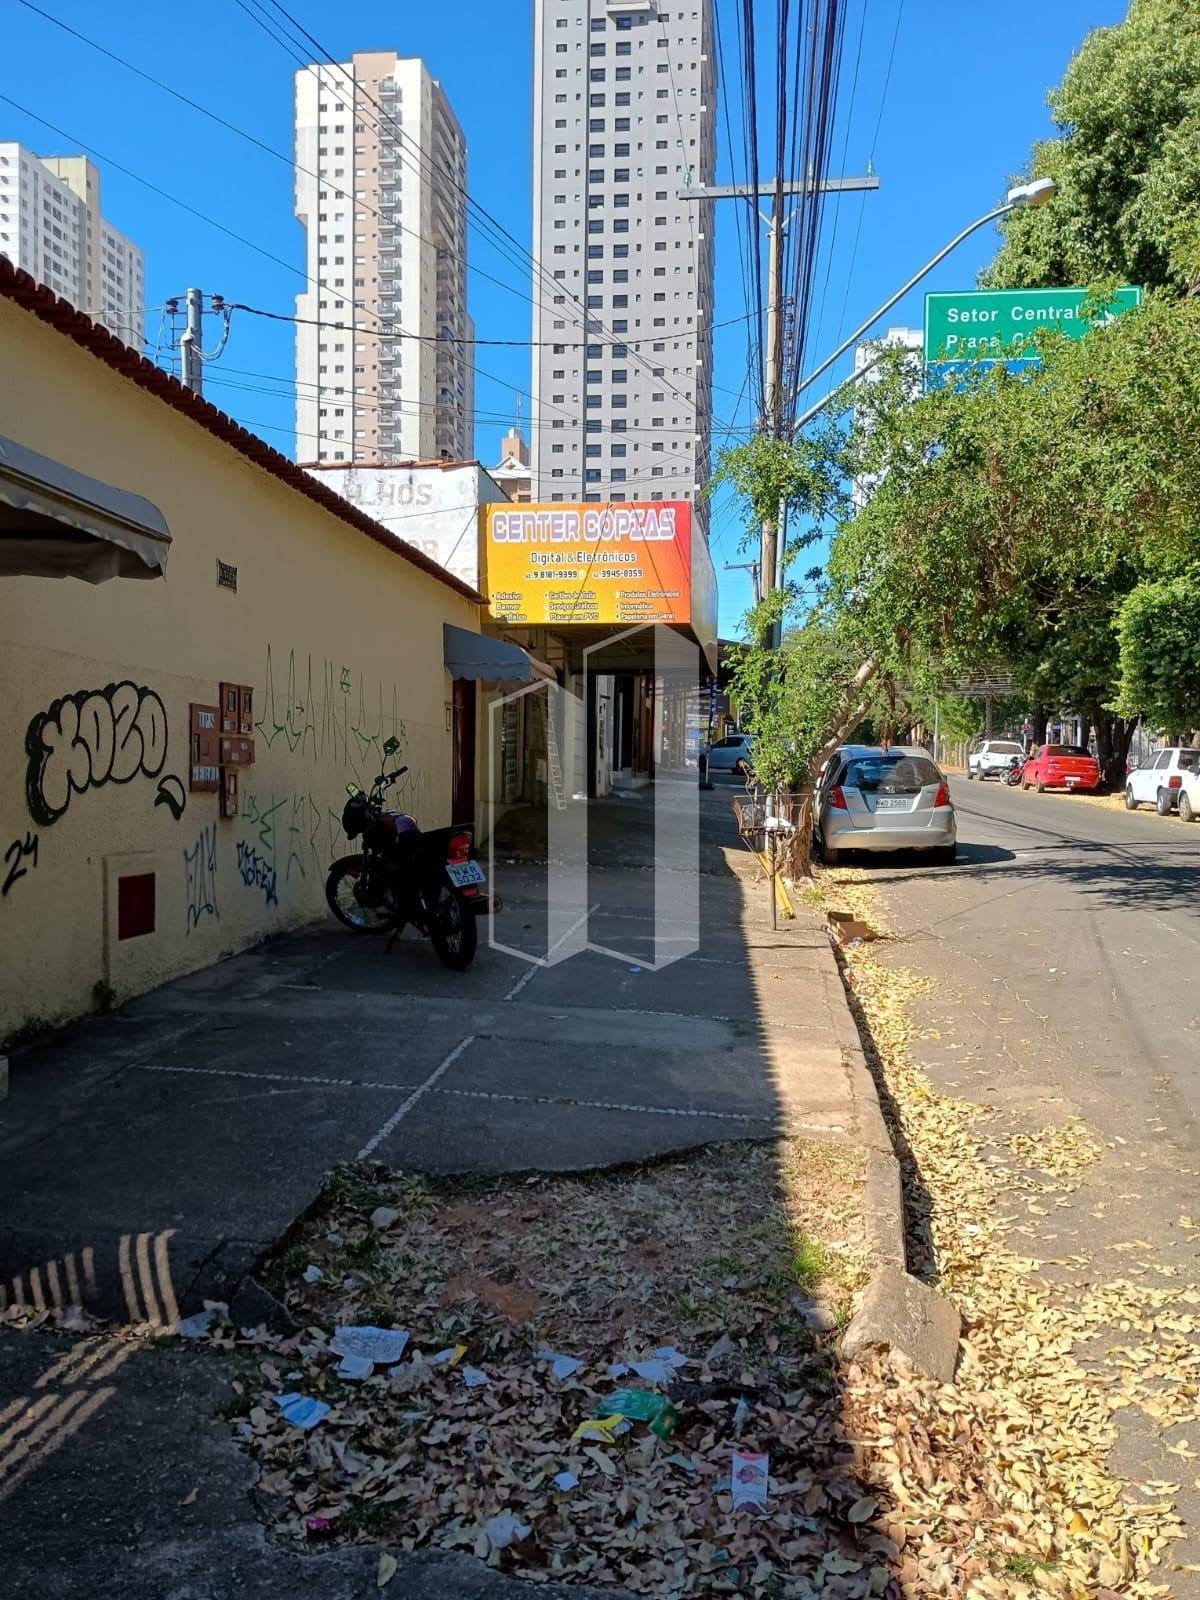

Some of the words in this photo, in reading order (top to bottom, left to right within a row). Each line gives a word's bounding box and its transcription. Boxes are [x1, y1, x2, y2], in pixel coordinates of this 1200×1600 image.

[947, 308, 999, 323] Setor
[1011, 304, 1079, 321] Central
[492, 510, 579, 543] CENTER
[531, 552, 564, 565] Digital
[567, 554, 574, 563] &
[576, 551, 637, 563] Eletrônicos
[496, 602, 521, 611] Banner
